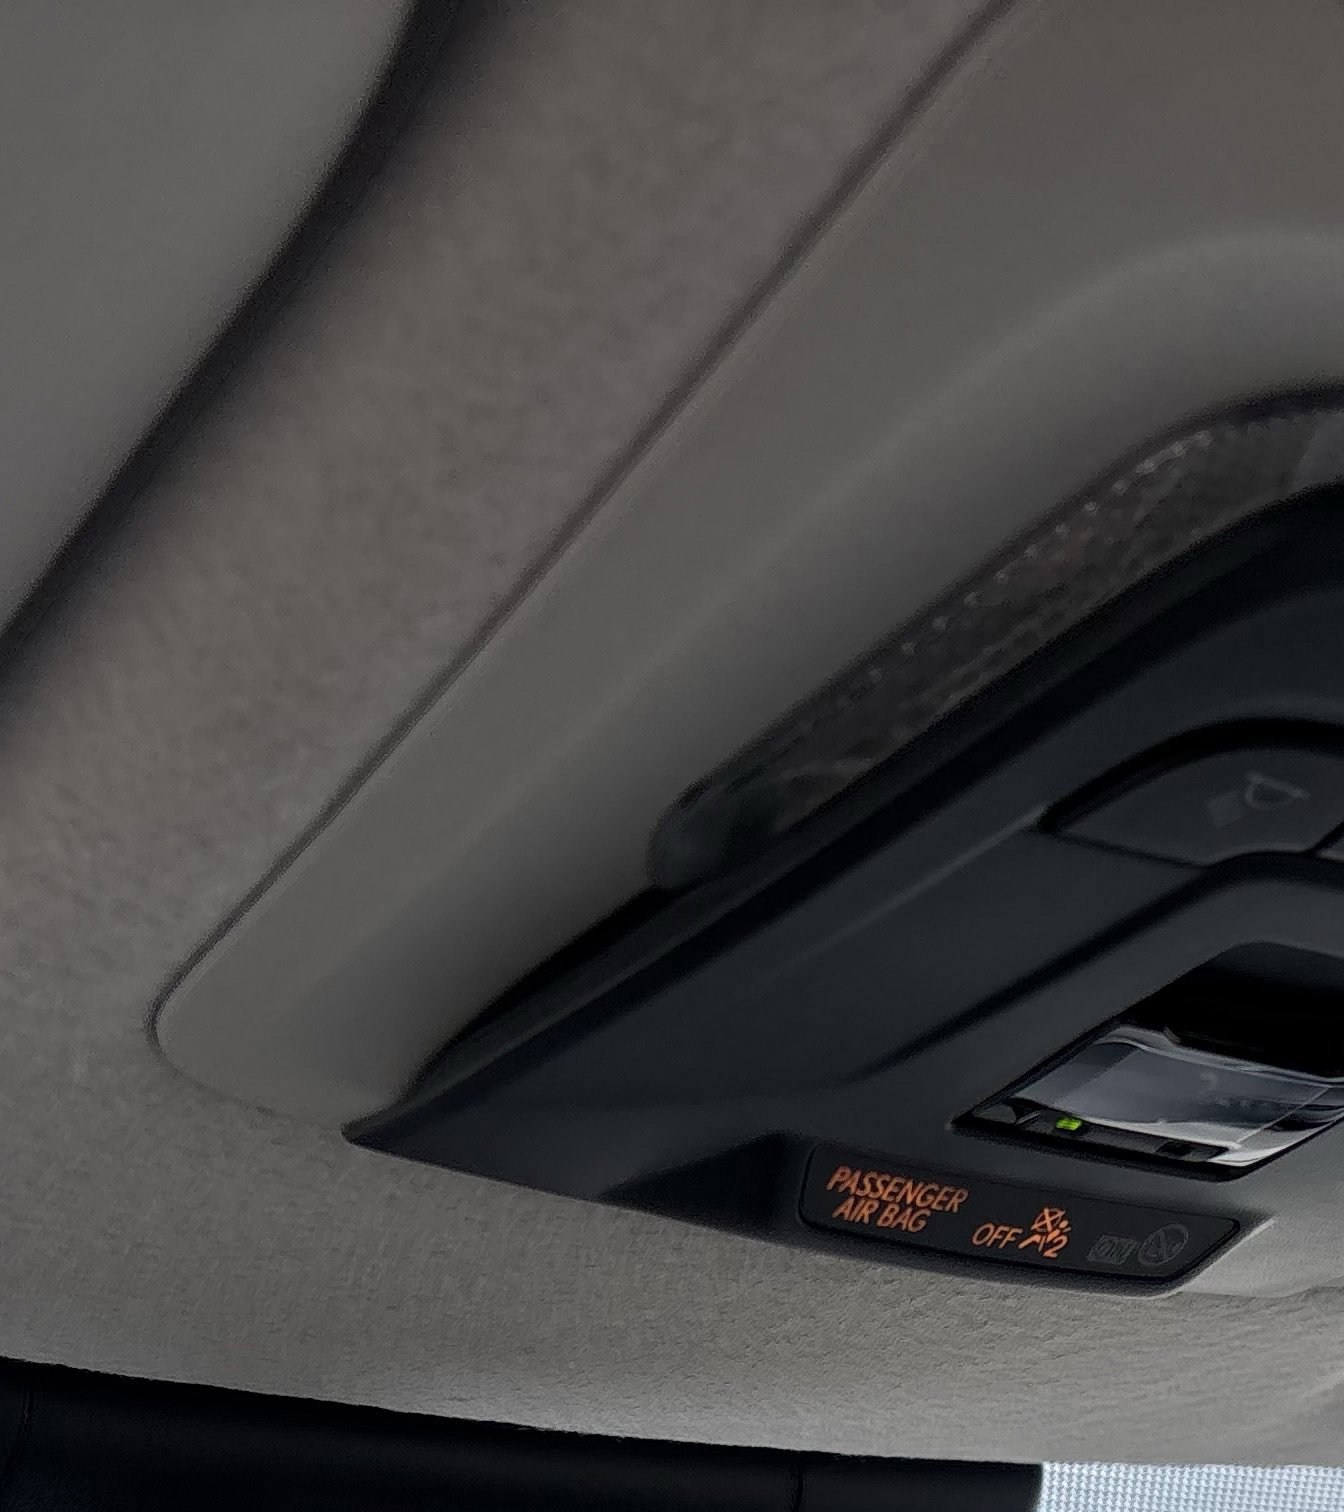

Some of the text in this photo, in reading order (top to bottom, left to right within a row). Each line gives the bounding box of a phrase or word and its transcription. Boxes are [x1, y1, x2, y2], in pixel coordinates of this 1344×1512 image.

[826, 1165, 969, 1213] PASSENGER
[832, 1196, 931, 1232] AIR BAG
[972, 1222, 1024, 1249] OFF
